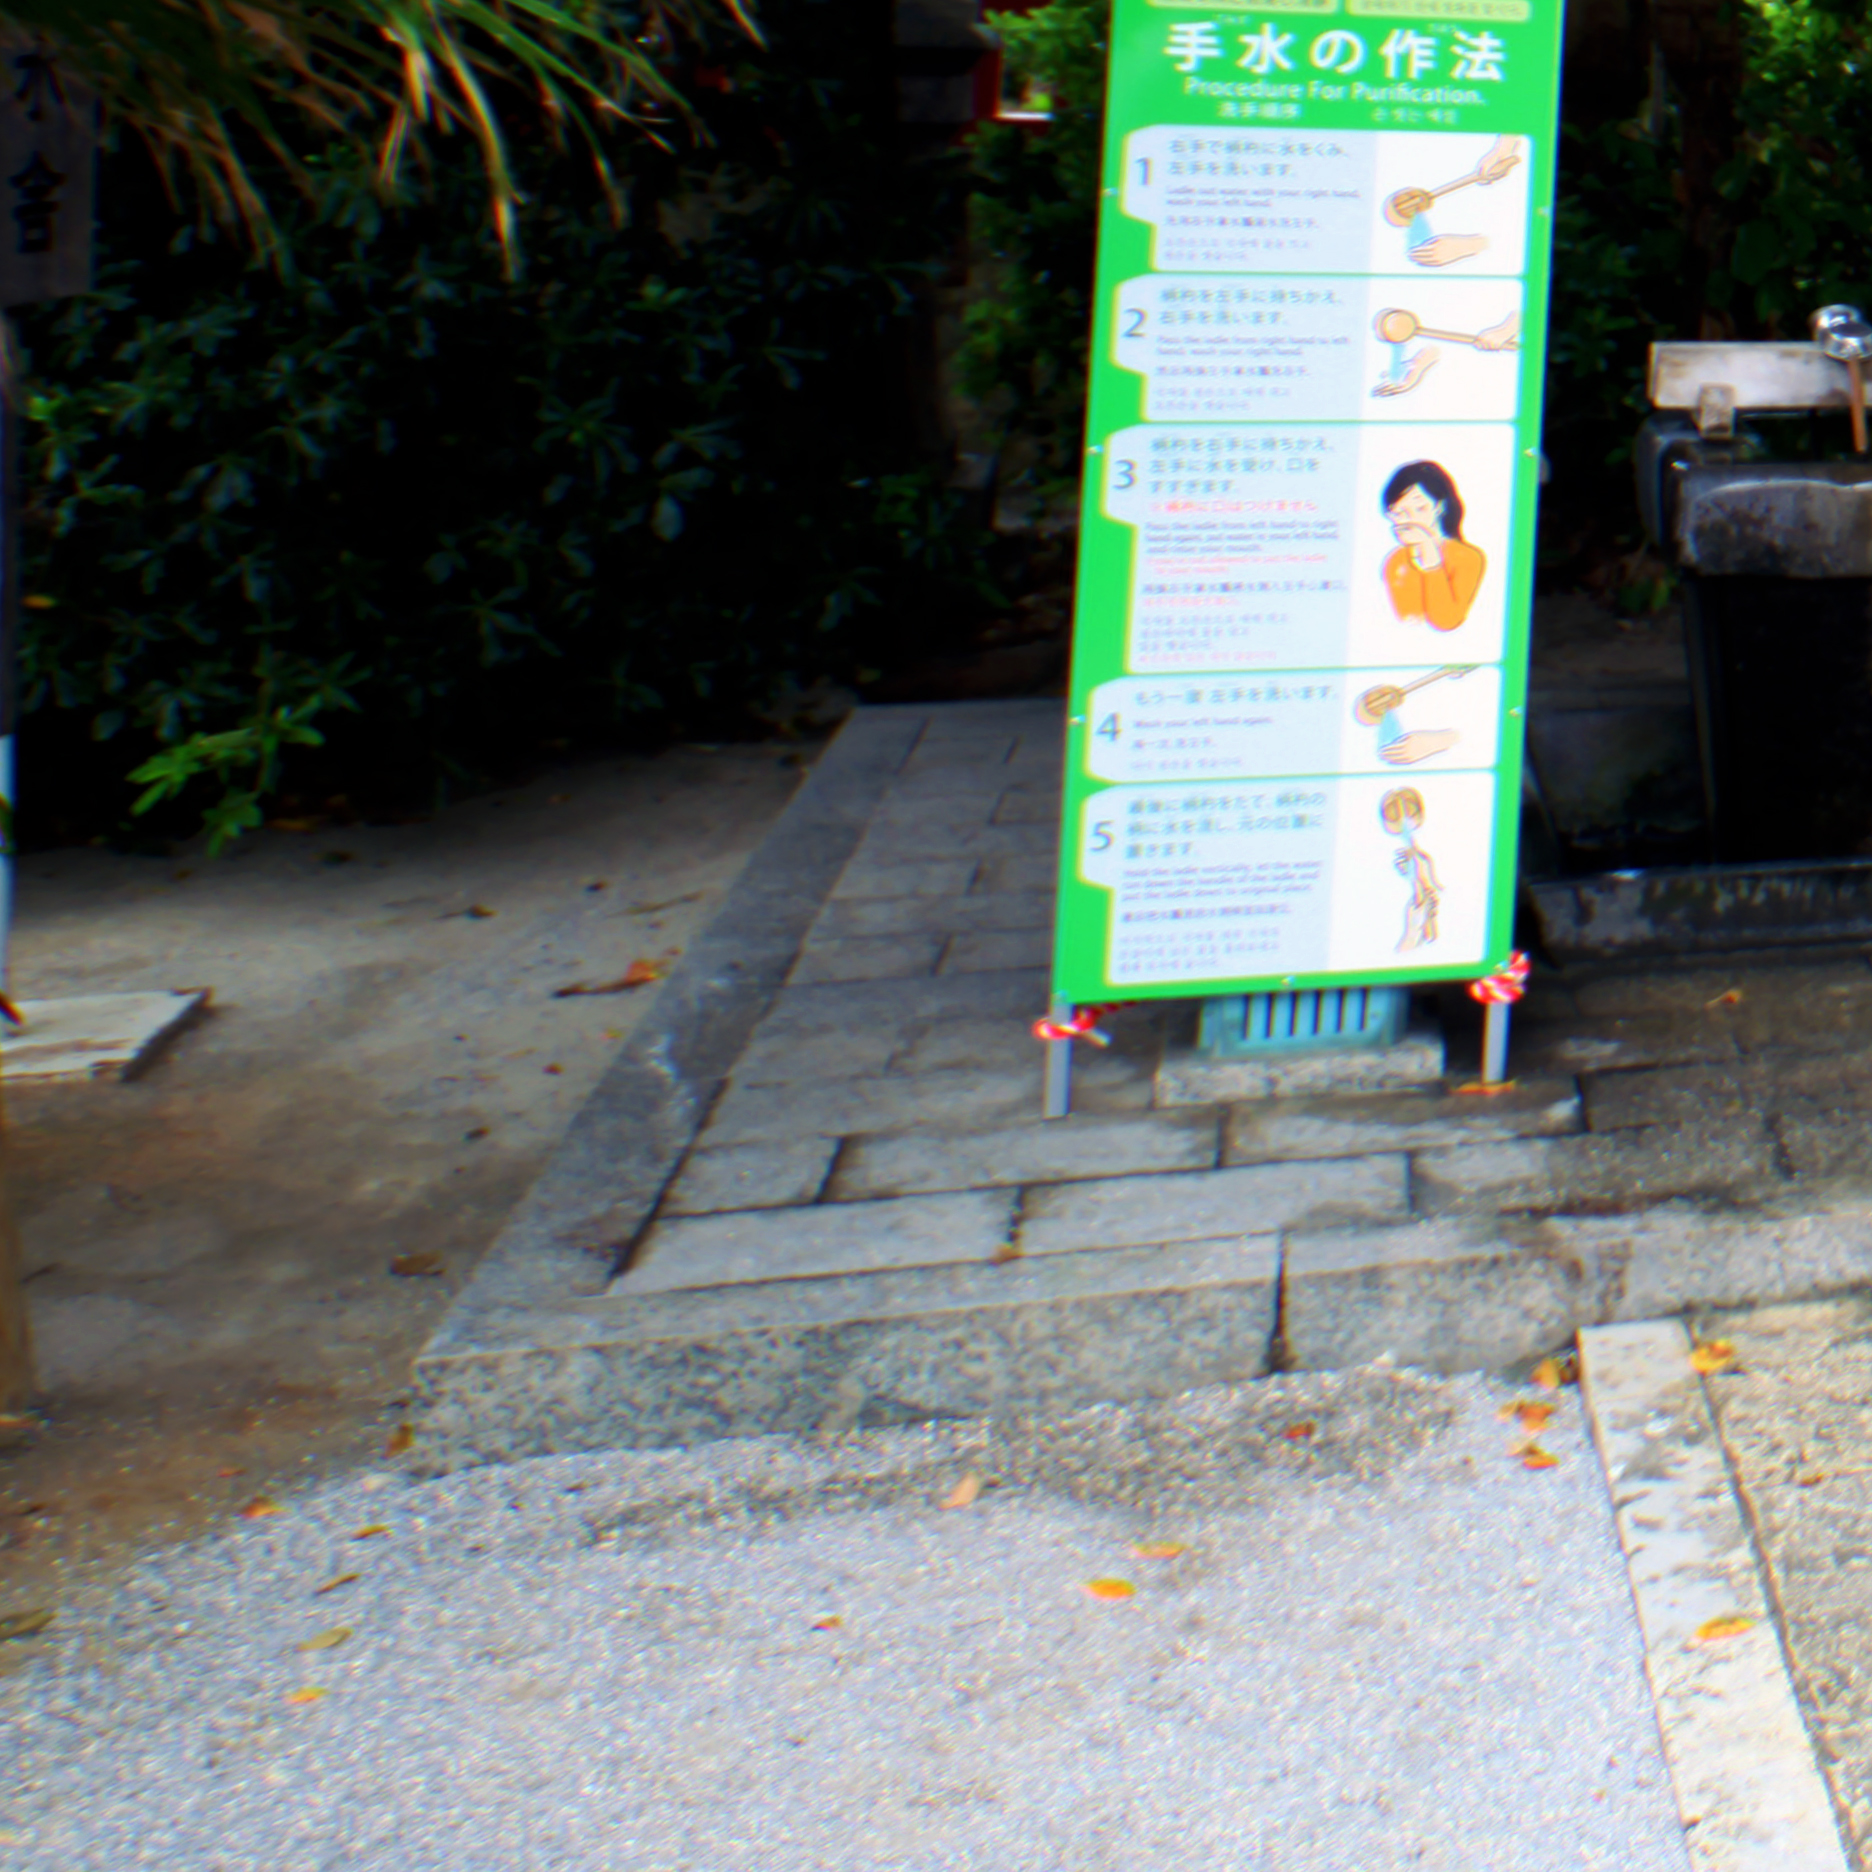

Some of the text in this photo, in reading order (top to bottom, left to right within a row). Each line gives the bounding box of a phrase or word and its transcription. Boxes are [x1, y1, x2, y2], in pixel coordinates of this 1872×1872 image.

[1163, 21, 1506, 82] 手水の作法
[1184, 75, 1487, 109] Procedure For Purification.
[1135, 156, 1153, 187] 1
[1122, 307, 1149, 339] 2
[1113, 458, 1138, 490] 3
[1096, 712, 1122, 742] 4
[1090, 821, 1115, 852] 5
